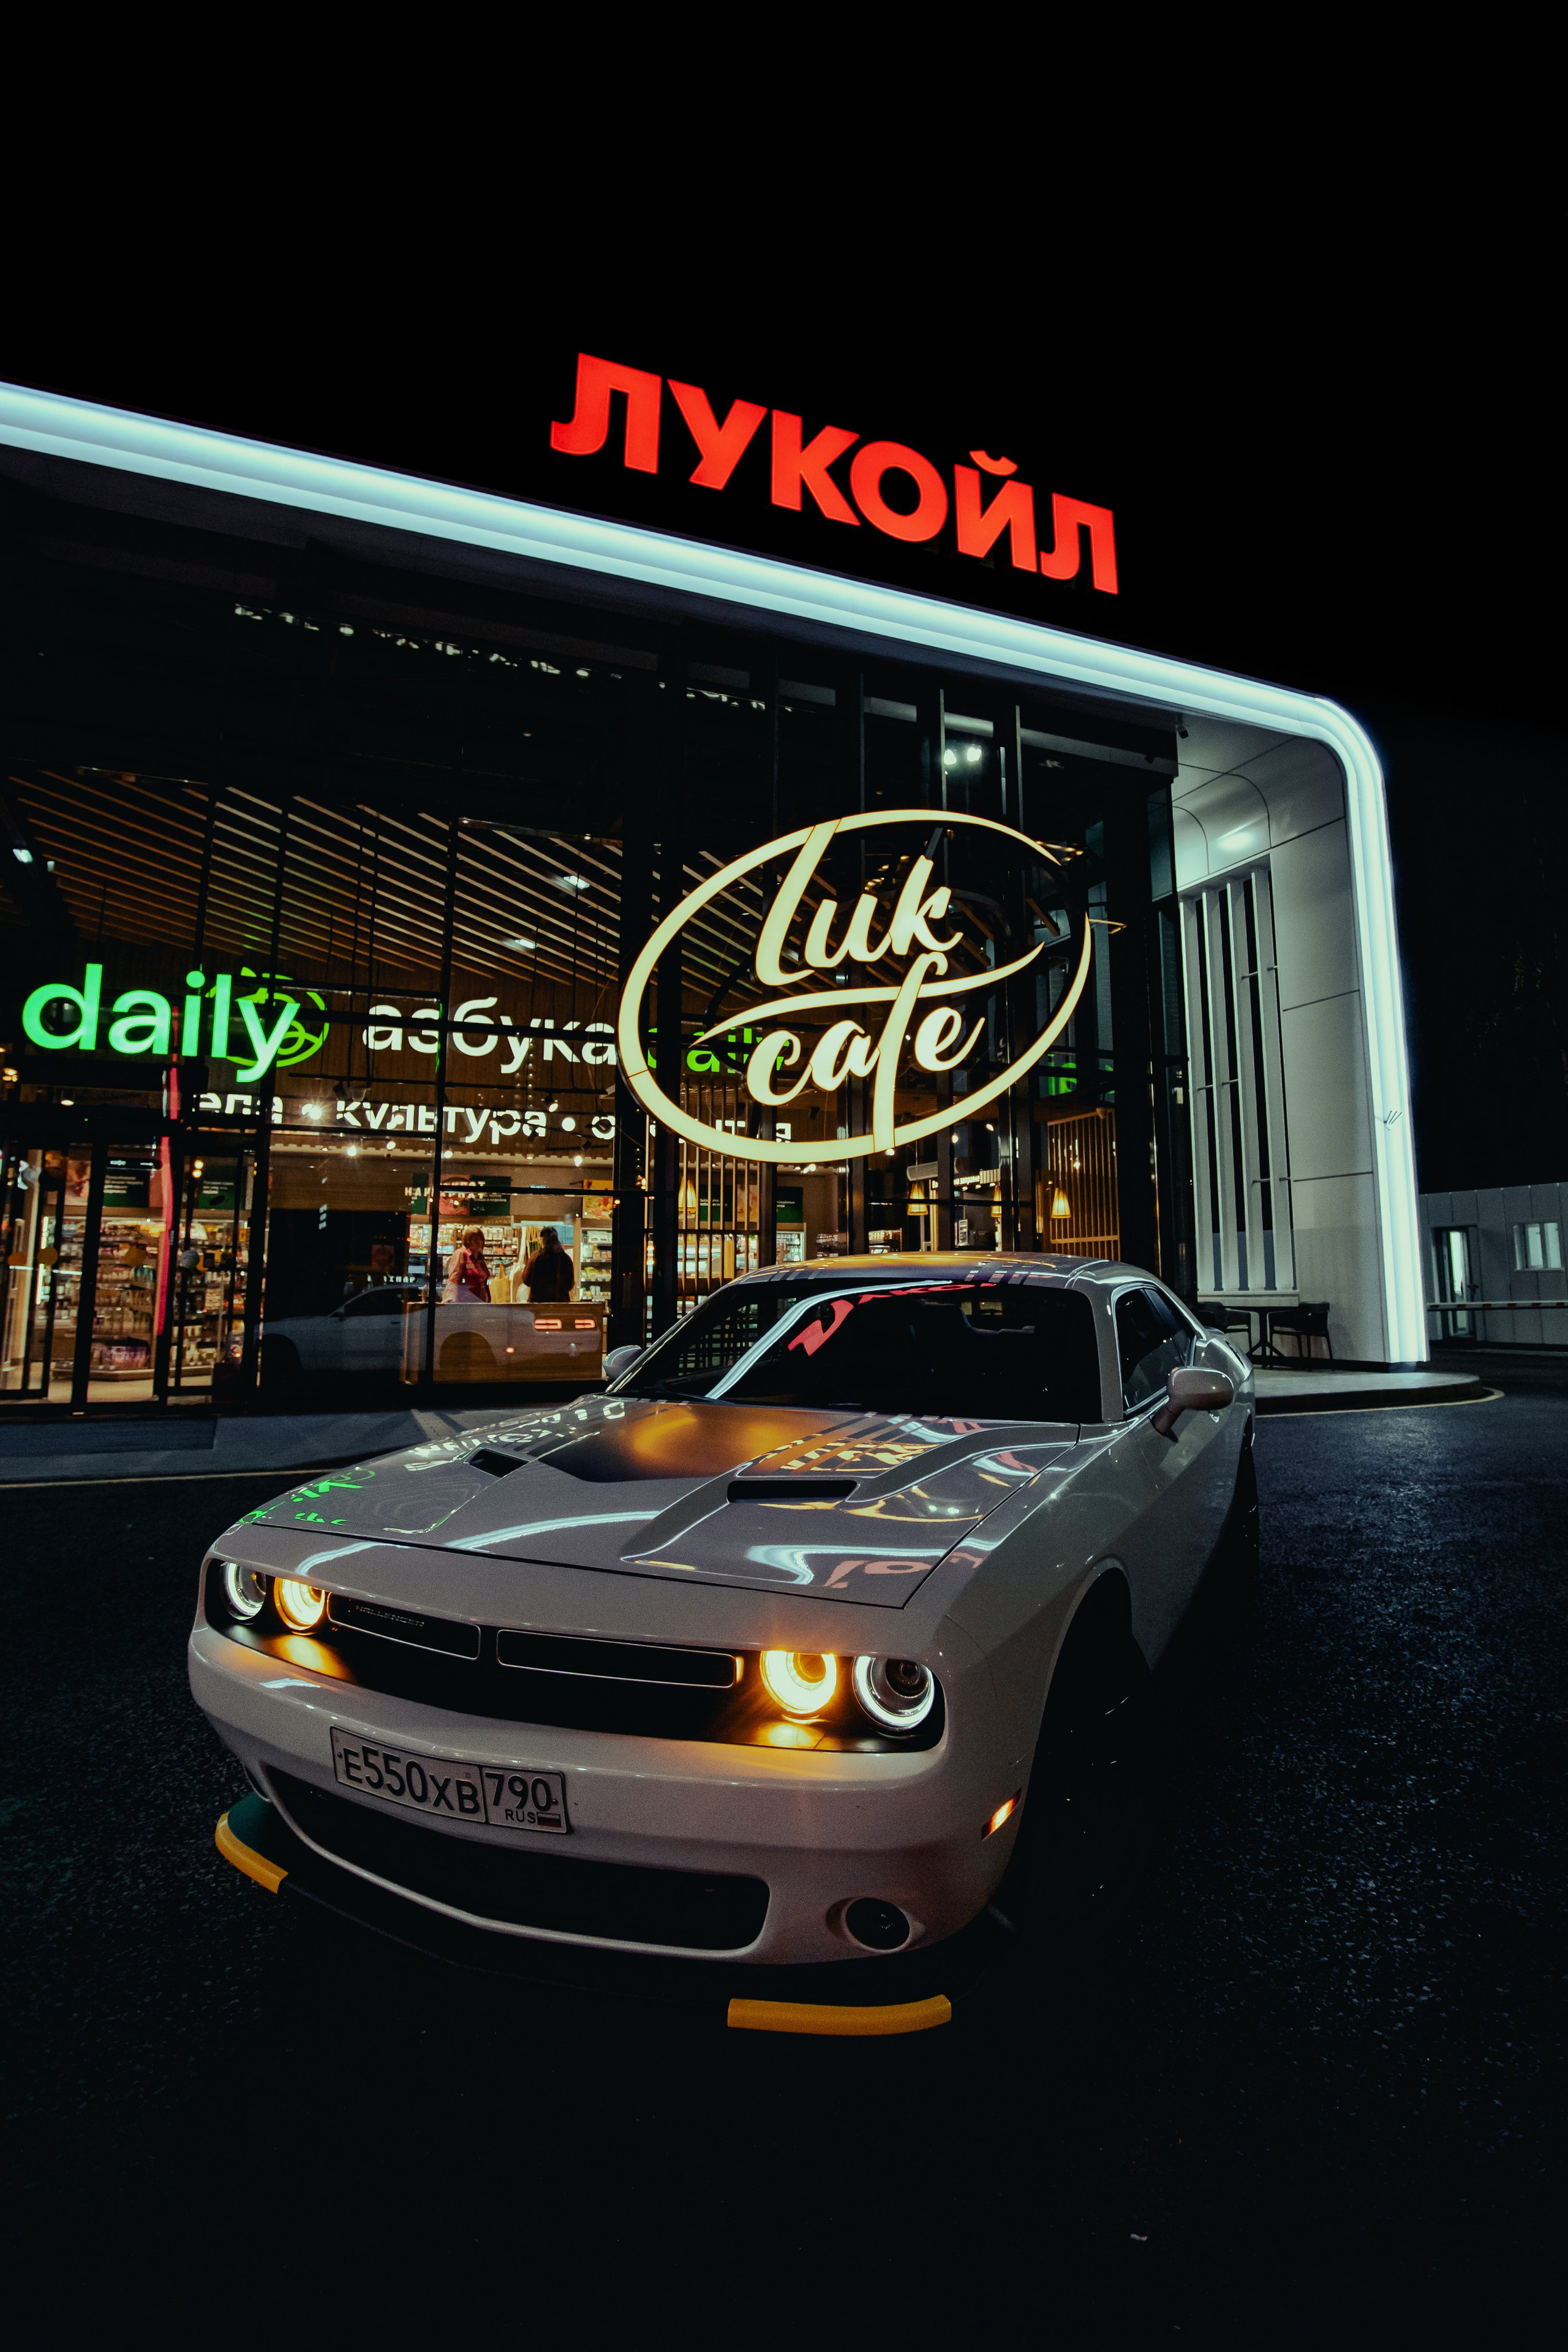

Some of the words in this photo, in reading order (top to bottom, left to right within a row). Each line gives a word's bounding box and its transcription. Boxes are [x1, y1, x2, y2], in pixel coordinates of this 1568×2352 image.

[550, 352, 1118, 595] ЛУКОЙЛ
[22, 963, 301, 1083] daily
[362, 996, 617, 1074] азбука
[354, 1604, 426, 1627] HALLENGER
[485, 1771, 552, 1812] 790
[505, 1808, 537, 1825] RUS
